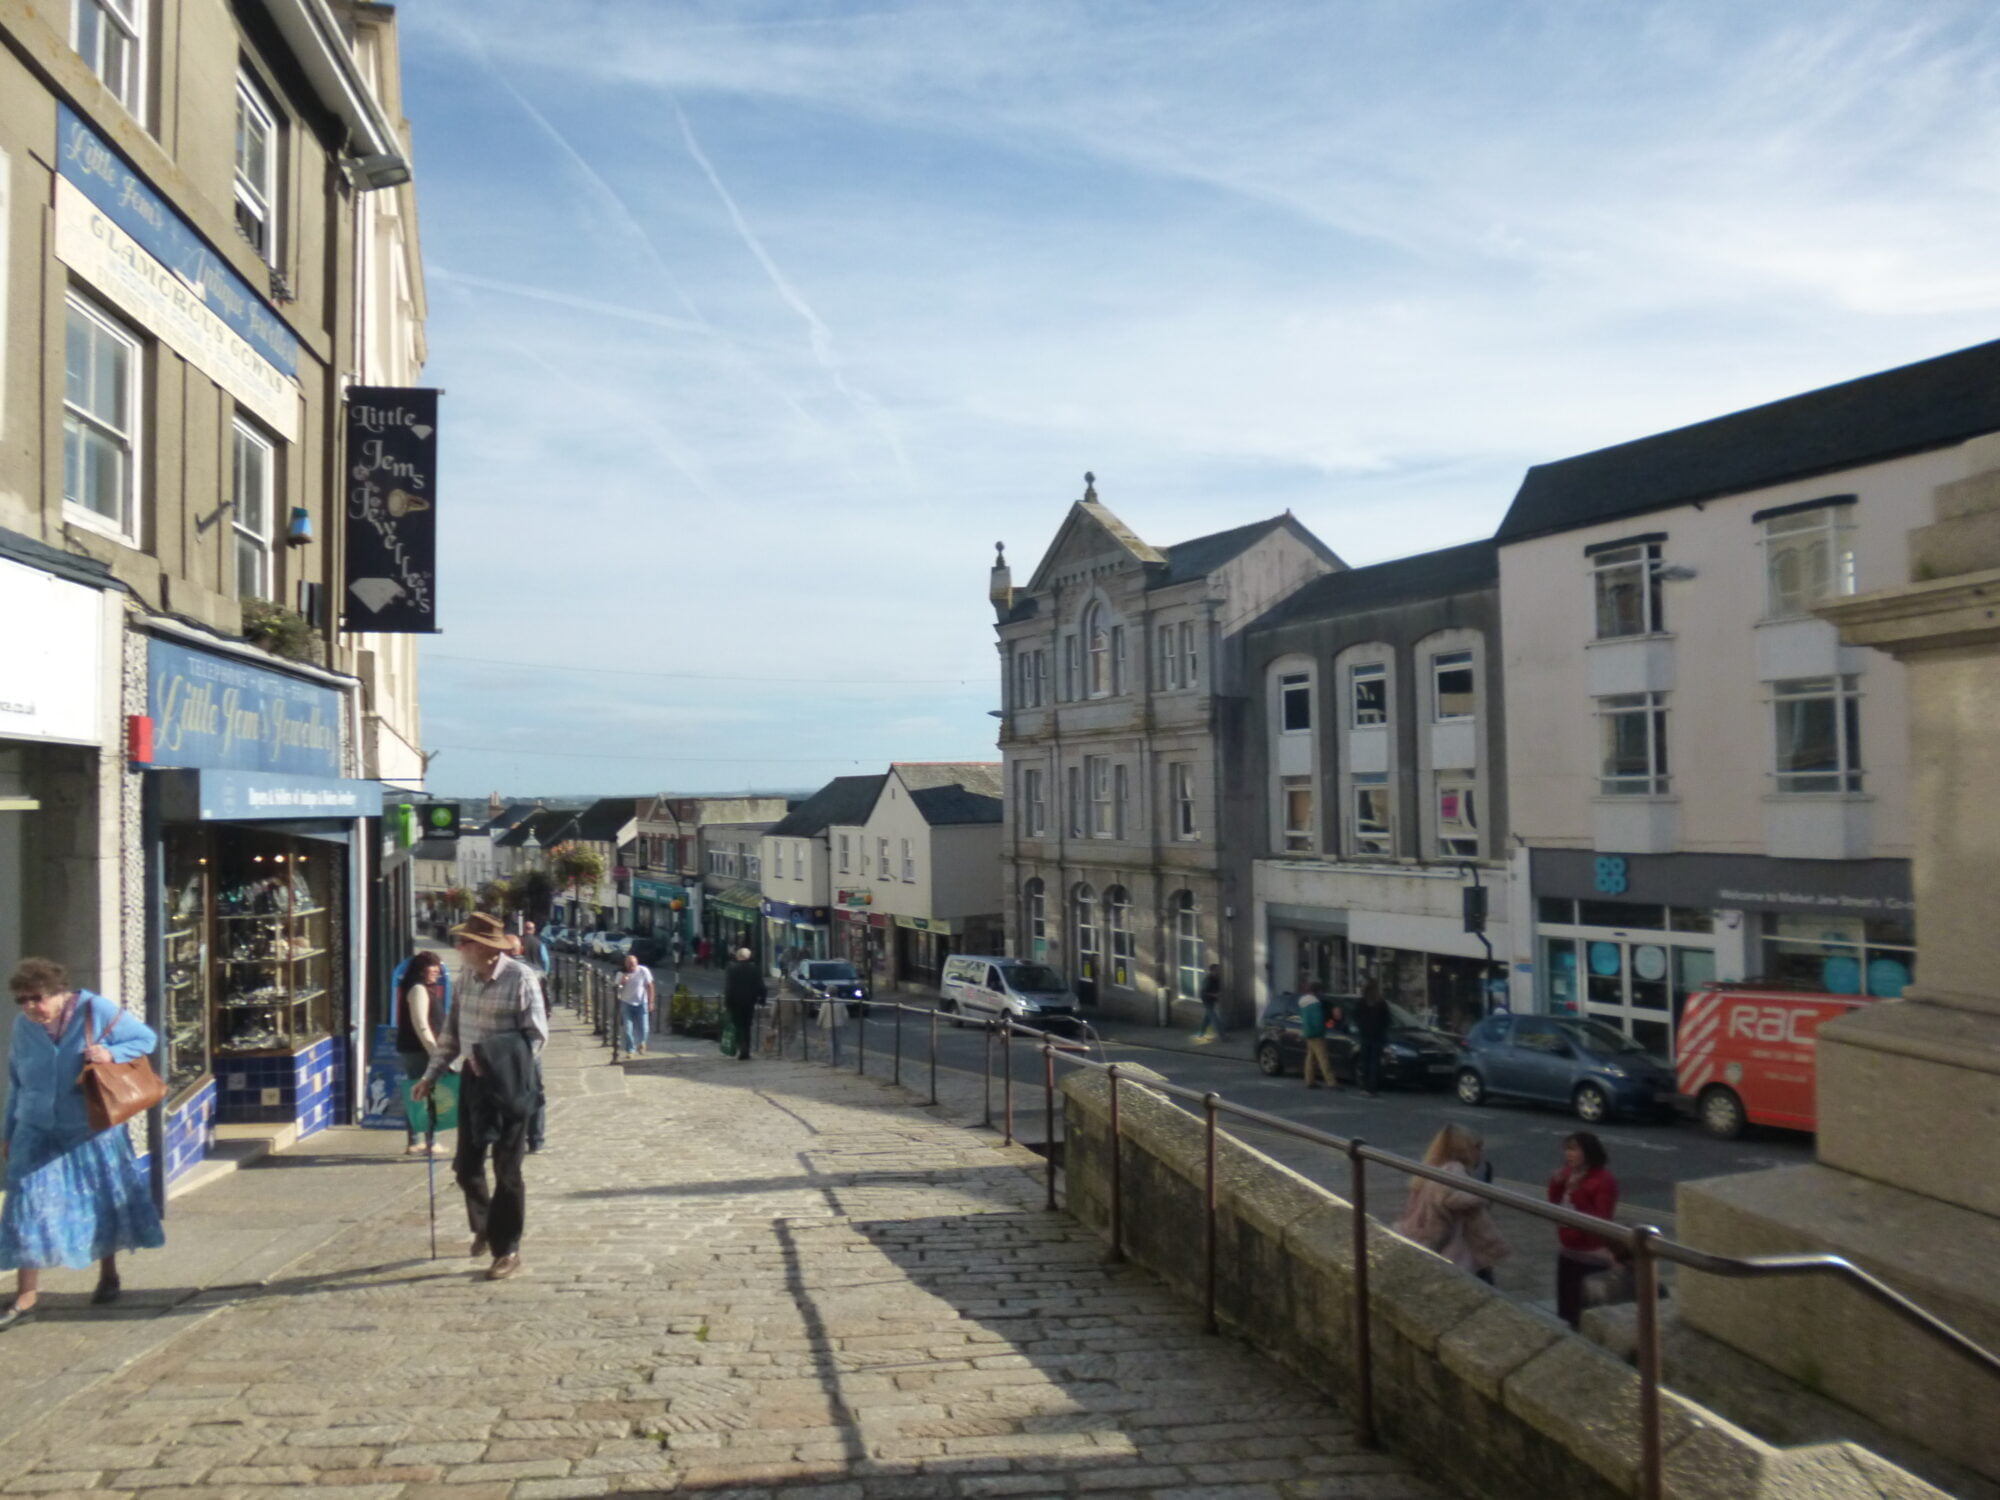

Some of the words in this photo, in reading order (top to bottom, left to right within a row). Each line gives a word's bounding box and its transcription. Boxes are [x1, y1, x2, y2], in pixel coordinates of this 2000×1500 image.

[90, 214, 224, 344] GLAMOROUS
[351, 405, 417, 433] Little
[362, 439, 426, 489] Jems
[349, 487, 432, 614] Jewellers
[153, 671, 218, 752] Little
